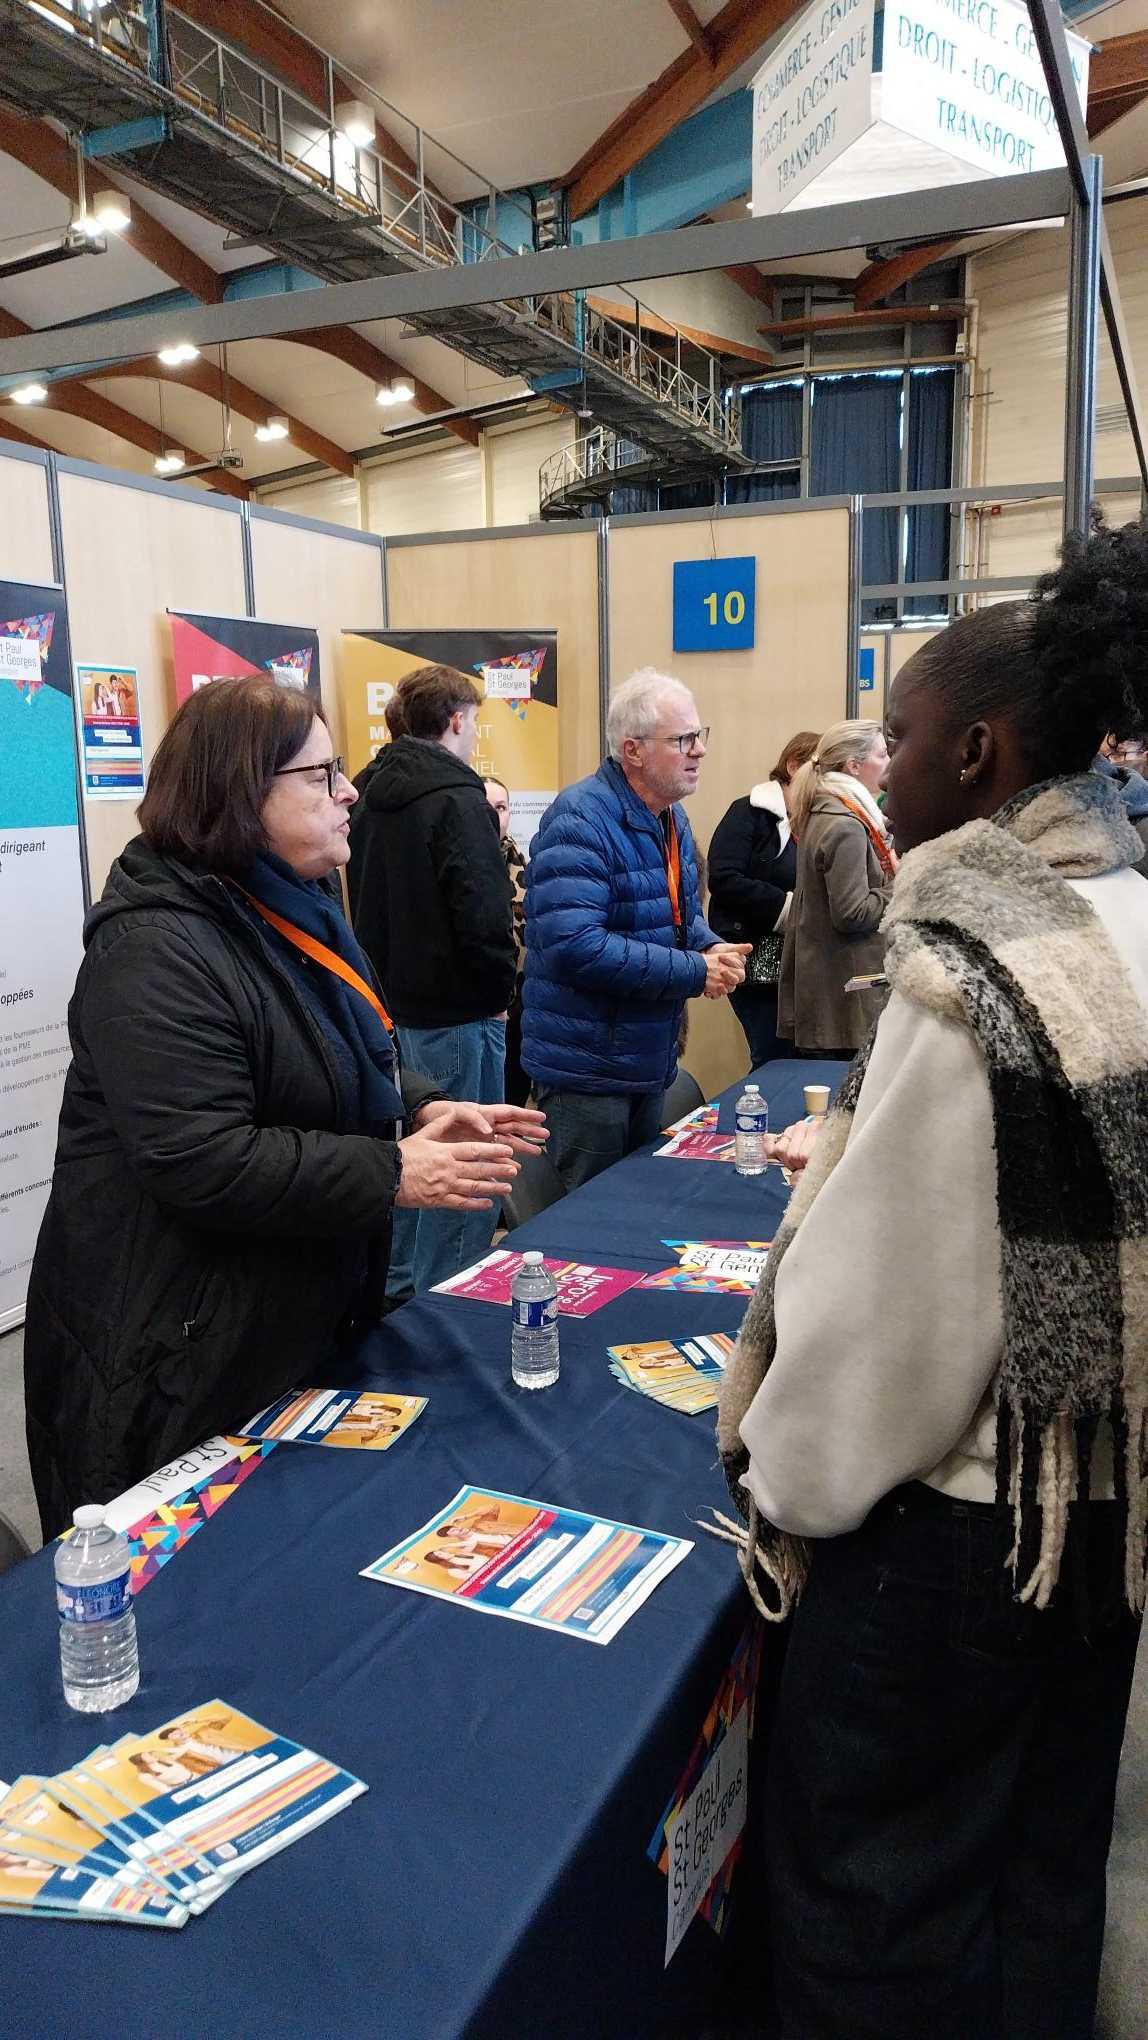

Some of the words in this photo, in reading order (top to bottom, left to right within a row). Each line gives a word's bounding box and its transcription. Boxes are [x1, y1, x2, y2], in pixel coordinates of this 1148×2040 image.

[898, 15, 957, 75] DROIT
[796, 26, 867, 126] LOGISTIQUE
[777, 107, 838, 193] TRANSPORT
[936, 96, 1036, 173] TRANSPORT
[703, 591, 745, 625] 10
[5, 641, 22, 655] Paul
[497, 671, 513, 681] Paul
[0, 840, 46, 856] dirigeant
[724, 1252, 766, 1264] Pau
[187, 1440, 228, 1461] St
[138, 1459, 200, 1494] Paul
[673, 1819, 692, 1867] St
[694, 1759, 722, 1836] Paul
[673, 1861, 690, 1908] St
[693, 1767, 744, 1873] Georges
